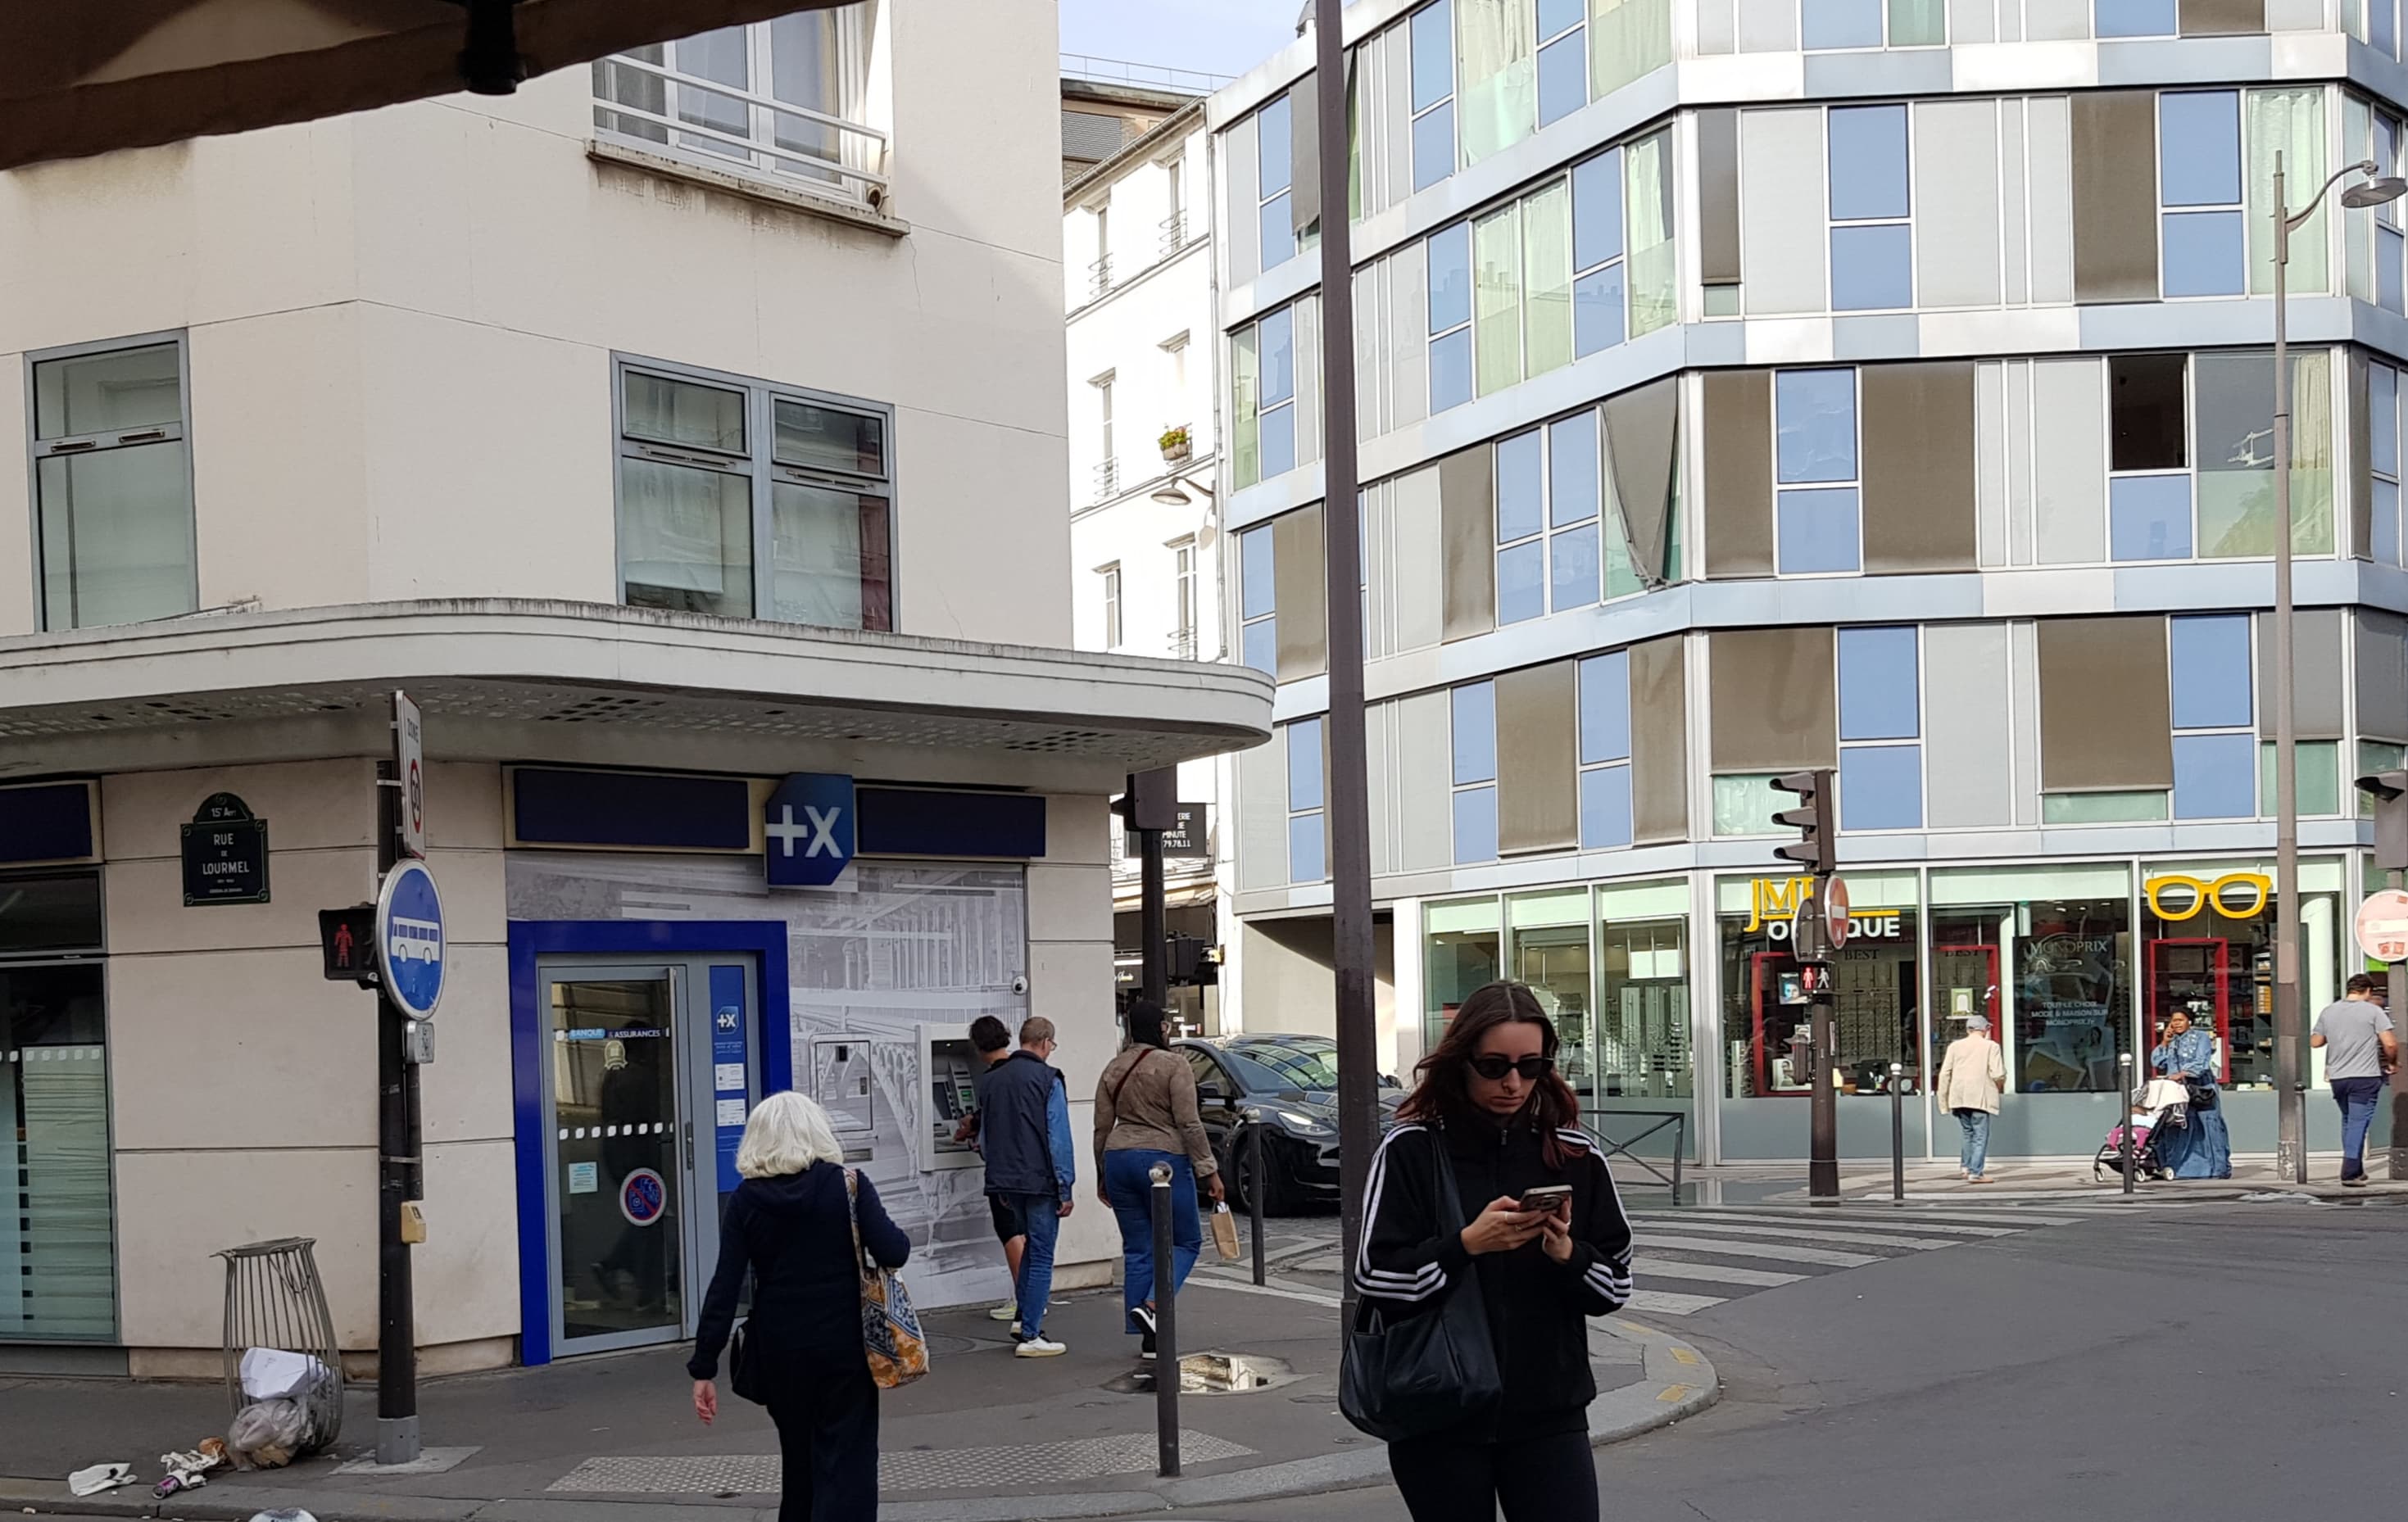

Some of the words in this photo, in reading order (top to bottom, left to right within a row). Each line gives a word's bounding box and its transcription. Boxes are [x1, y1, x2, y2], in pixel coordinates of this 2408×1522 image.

[213, 833, 234, 845] RUE
[202, 861, 250, 875] LOURMEL
[1767, 917, 1901, 940] OQUE
[2030, 940, 2108, 955] MONOPRIX
[1844, 949, 1880, 960] BEST
[570, 1029, 604, 1038] BANQUE
[614, 1029, 660, 1039] ASSURANCES
